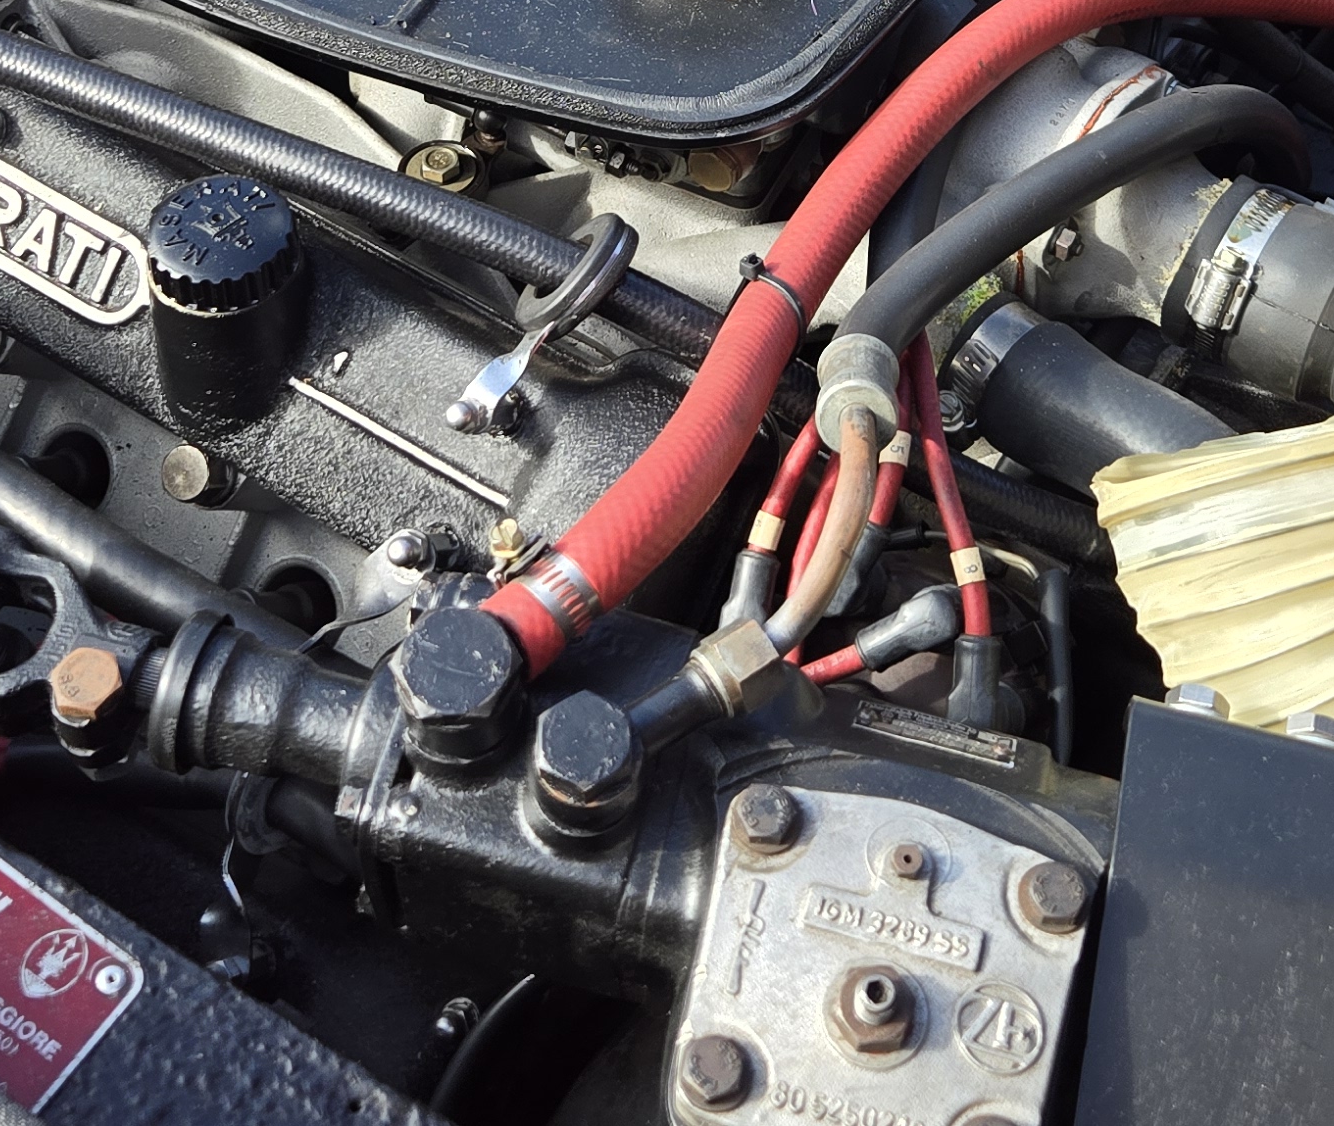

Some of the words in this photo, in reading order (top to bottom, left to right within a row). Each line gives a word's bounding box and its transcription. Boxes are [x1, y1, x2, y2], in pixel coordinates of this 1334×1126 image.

[158, 178, 276, 265] MASERATI
[963, 564, 979, 574] 8
[869, 910, 930, 948] 3289
[769, 1079, 807, 1115] 80
